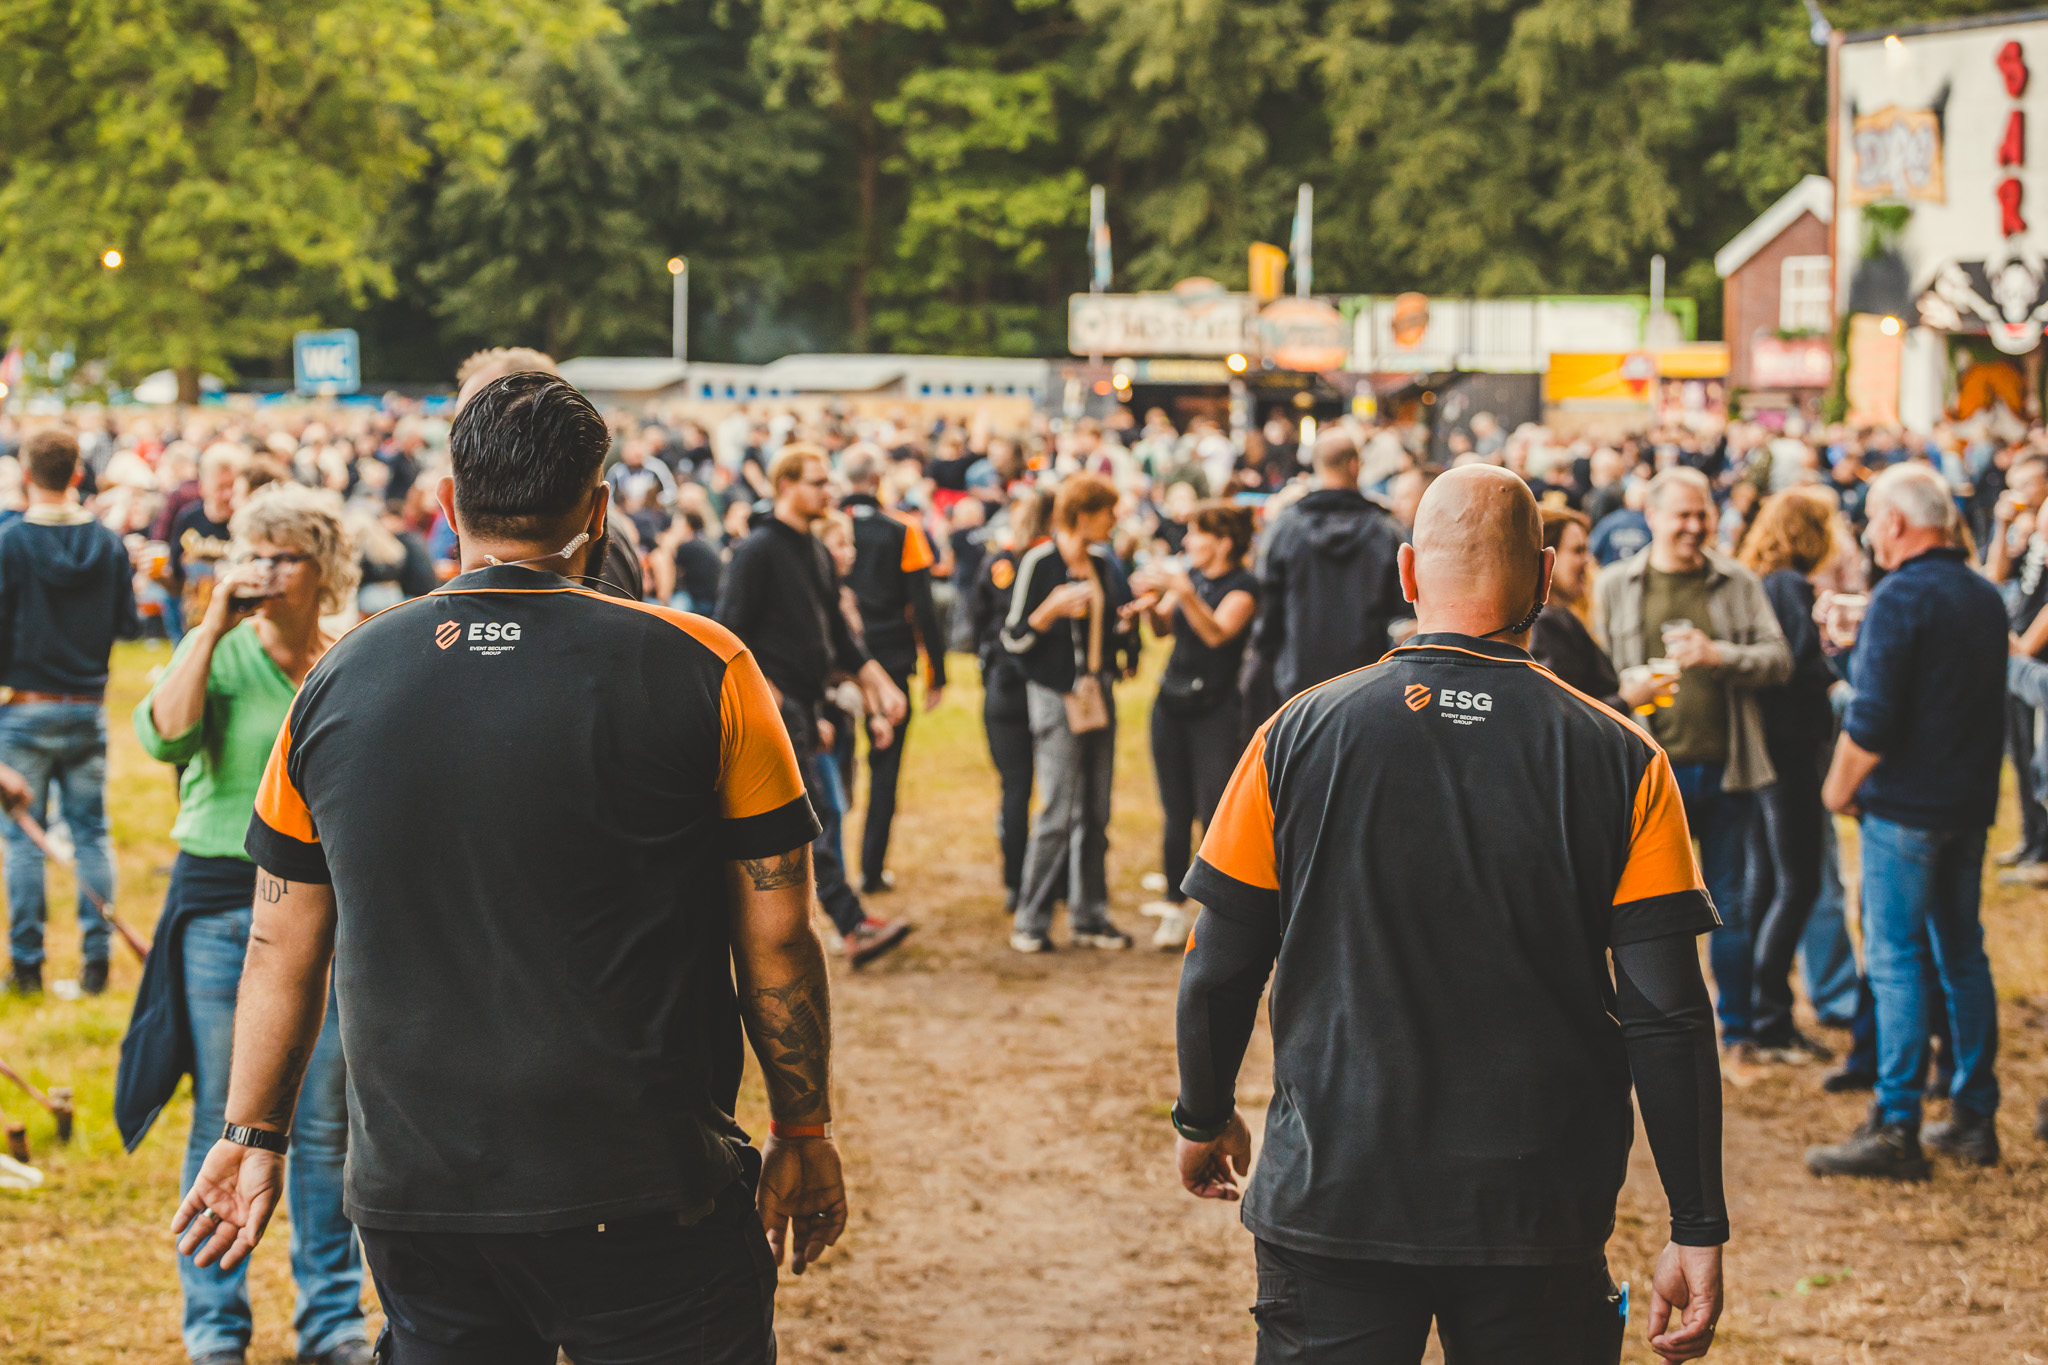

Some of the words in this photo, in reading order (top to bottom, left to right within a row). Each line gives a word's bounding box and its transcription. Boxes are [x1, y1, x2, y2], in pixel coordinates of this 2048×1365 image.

[302, 343, 350, 378] WC
[468, 622, 521, 641] ESG
[1439, 689, 1493, 711] ESG
[1459, 714, 1486, 722] SECURITY
